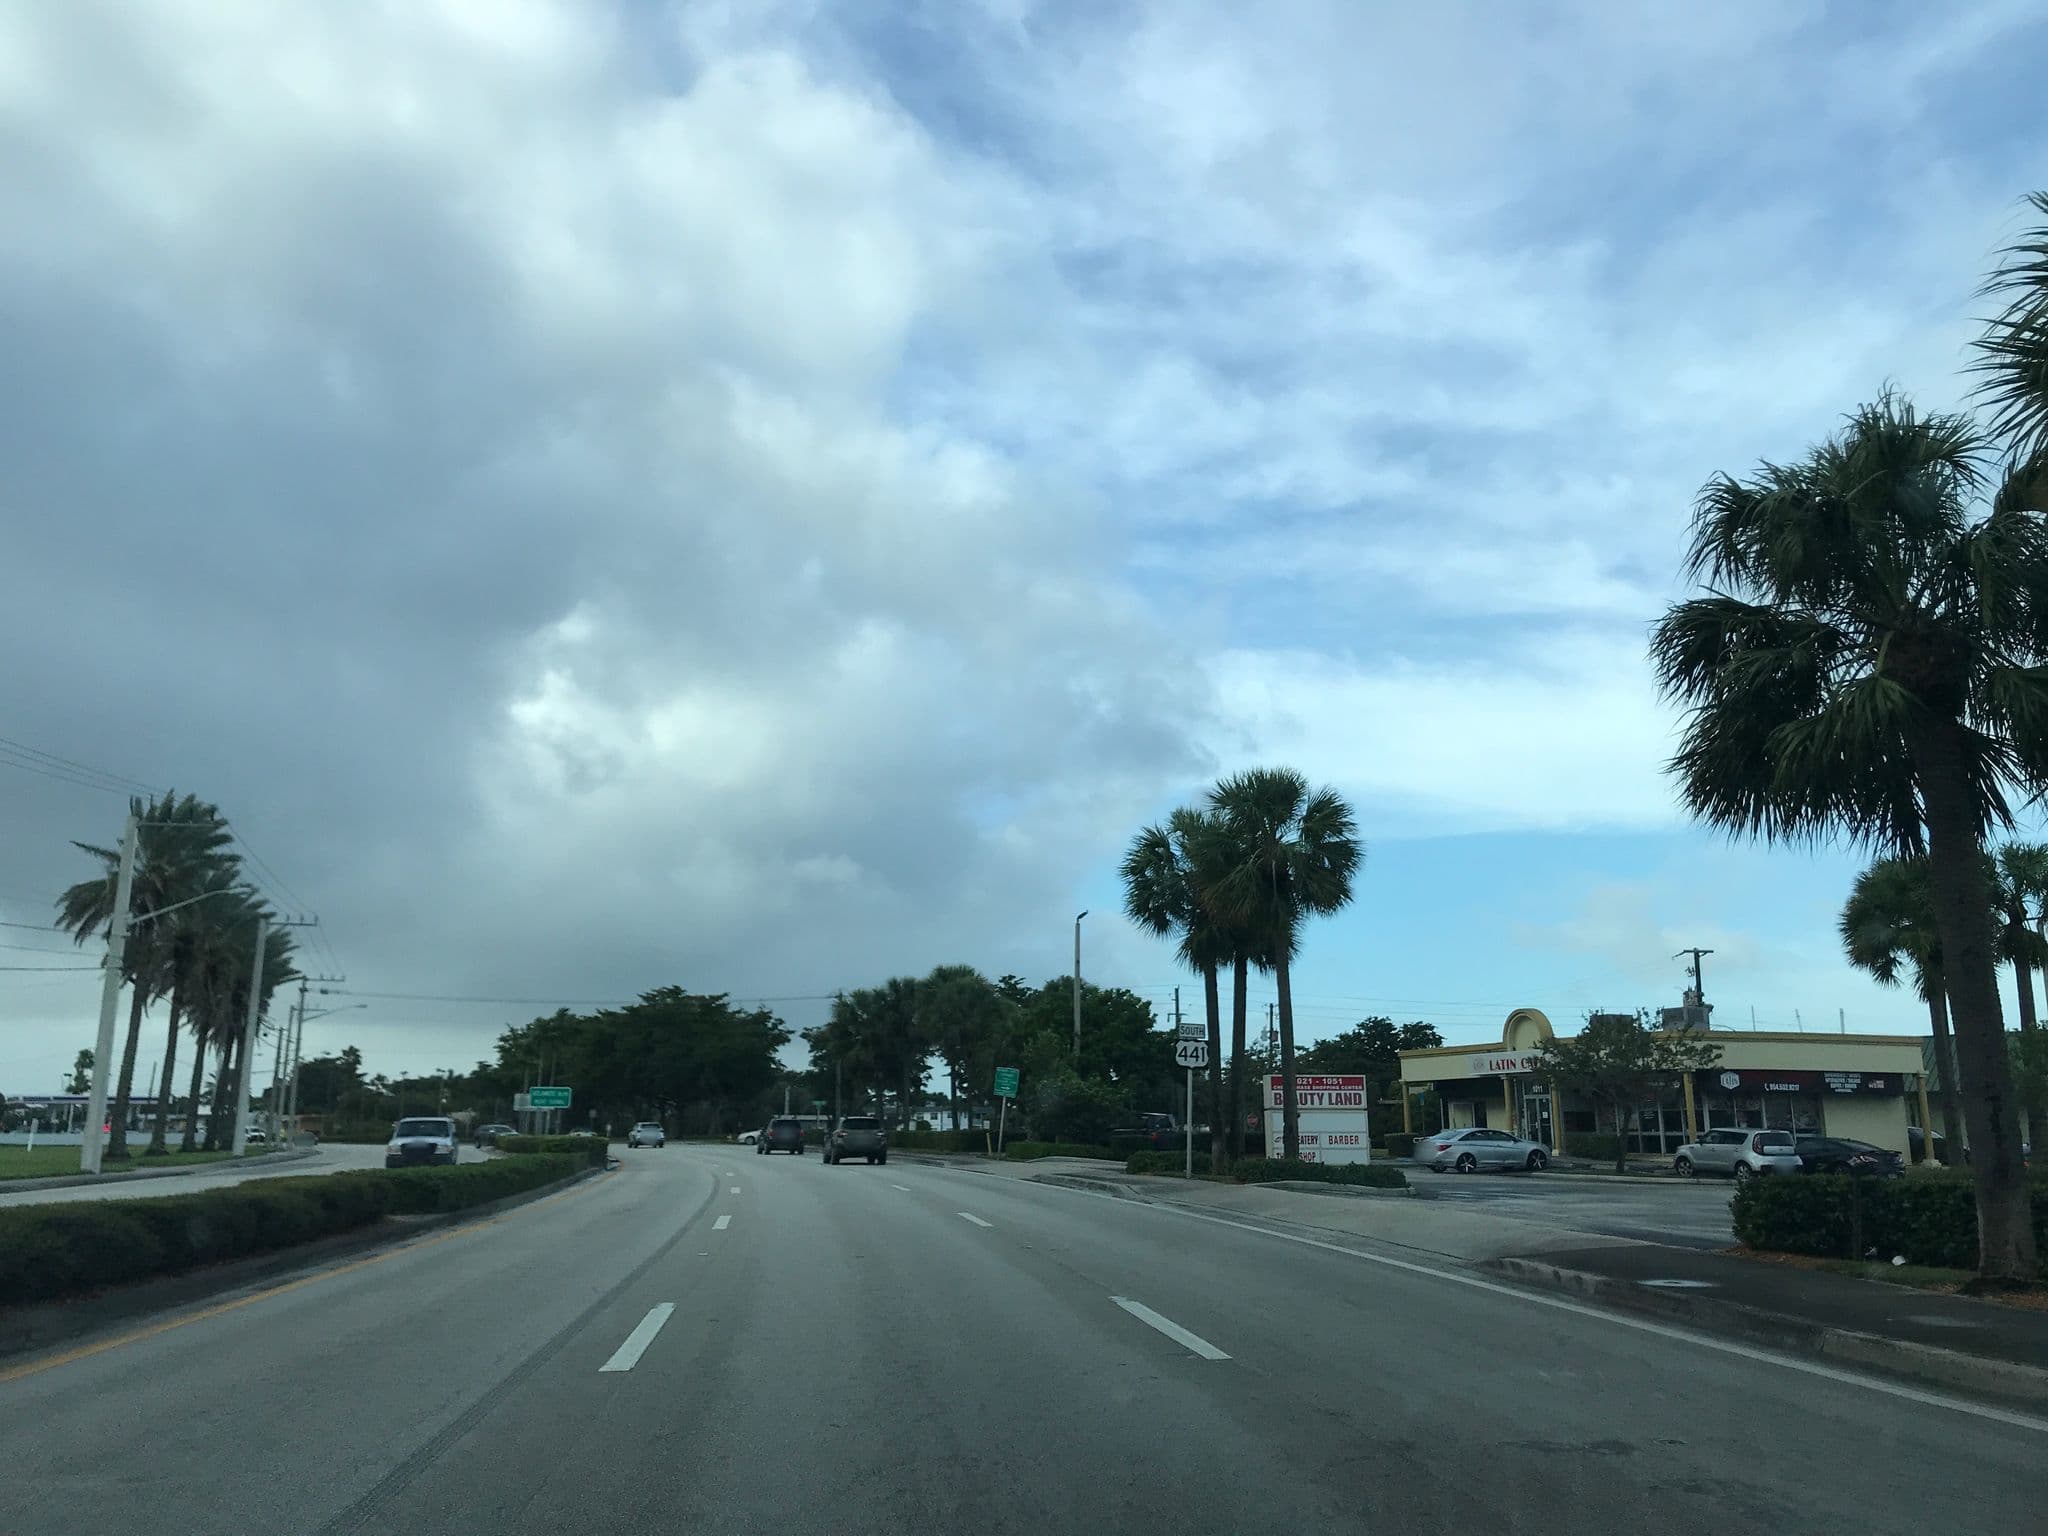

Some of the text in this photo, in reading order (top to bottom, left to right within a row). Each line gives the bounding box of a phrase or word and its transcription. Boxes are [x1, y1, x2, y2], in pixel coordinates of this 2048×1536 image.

[1180, 1025, 1203, 1035] SOUTH
[1177, 1045, 1206, 1063] 441
[1489, 1058, 1517, 1071] LATIN
[1274, 1092, 1362, 1105] BUTY LAND
[1328, 1136, 1359, 1144] BARBER
